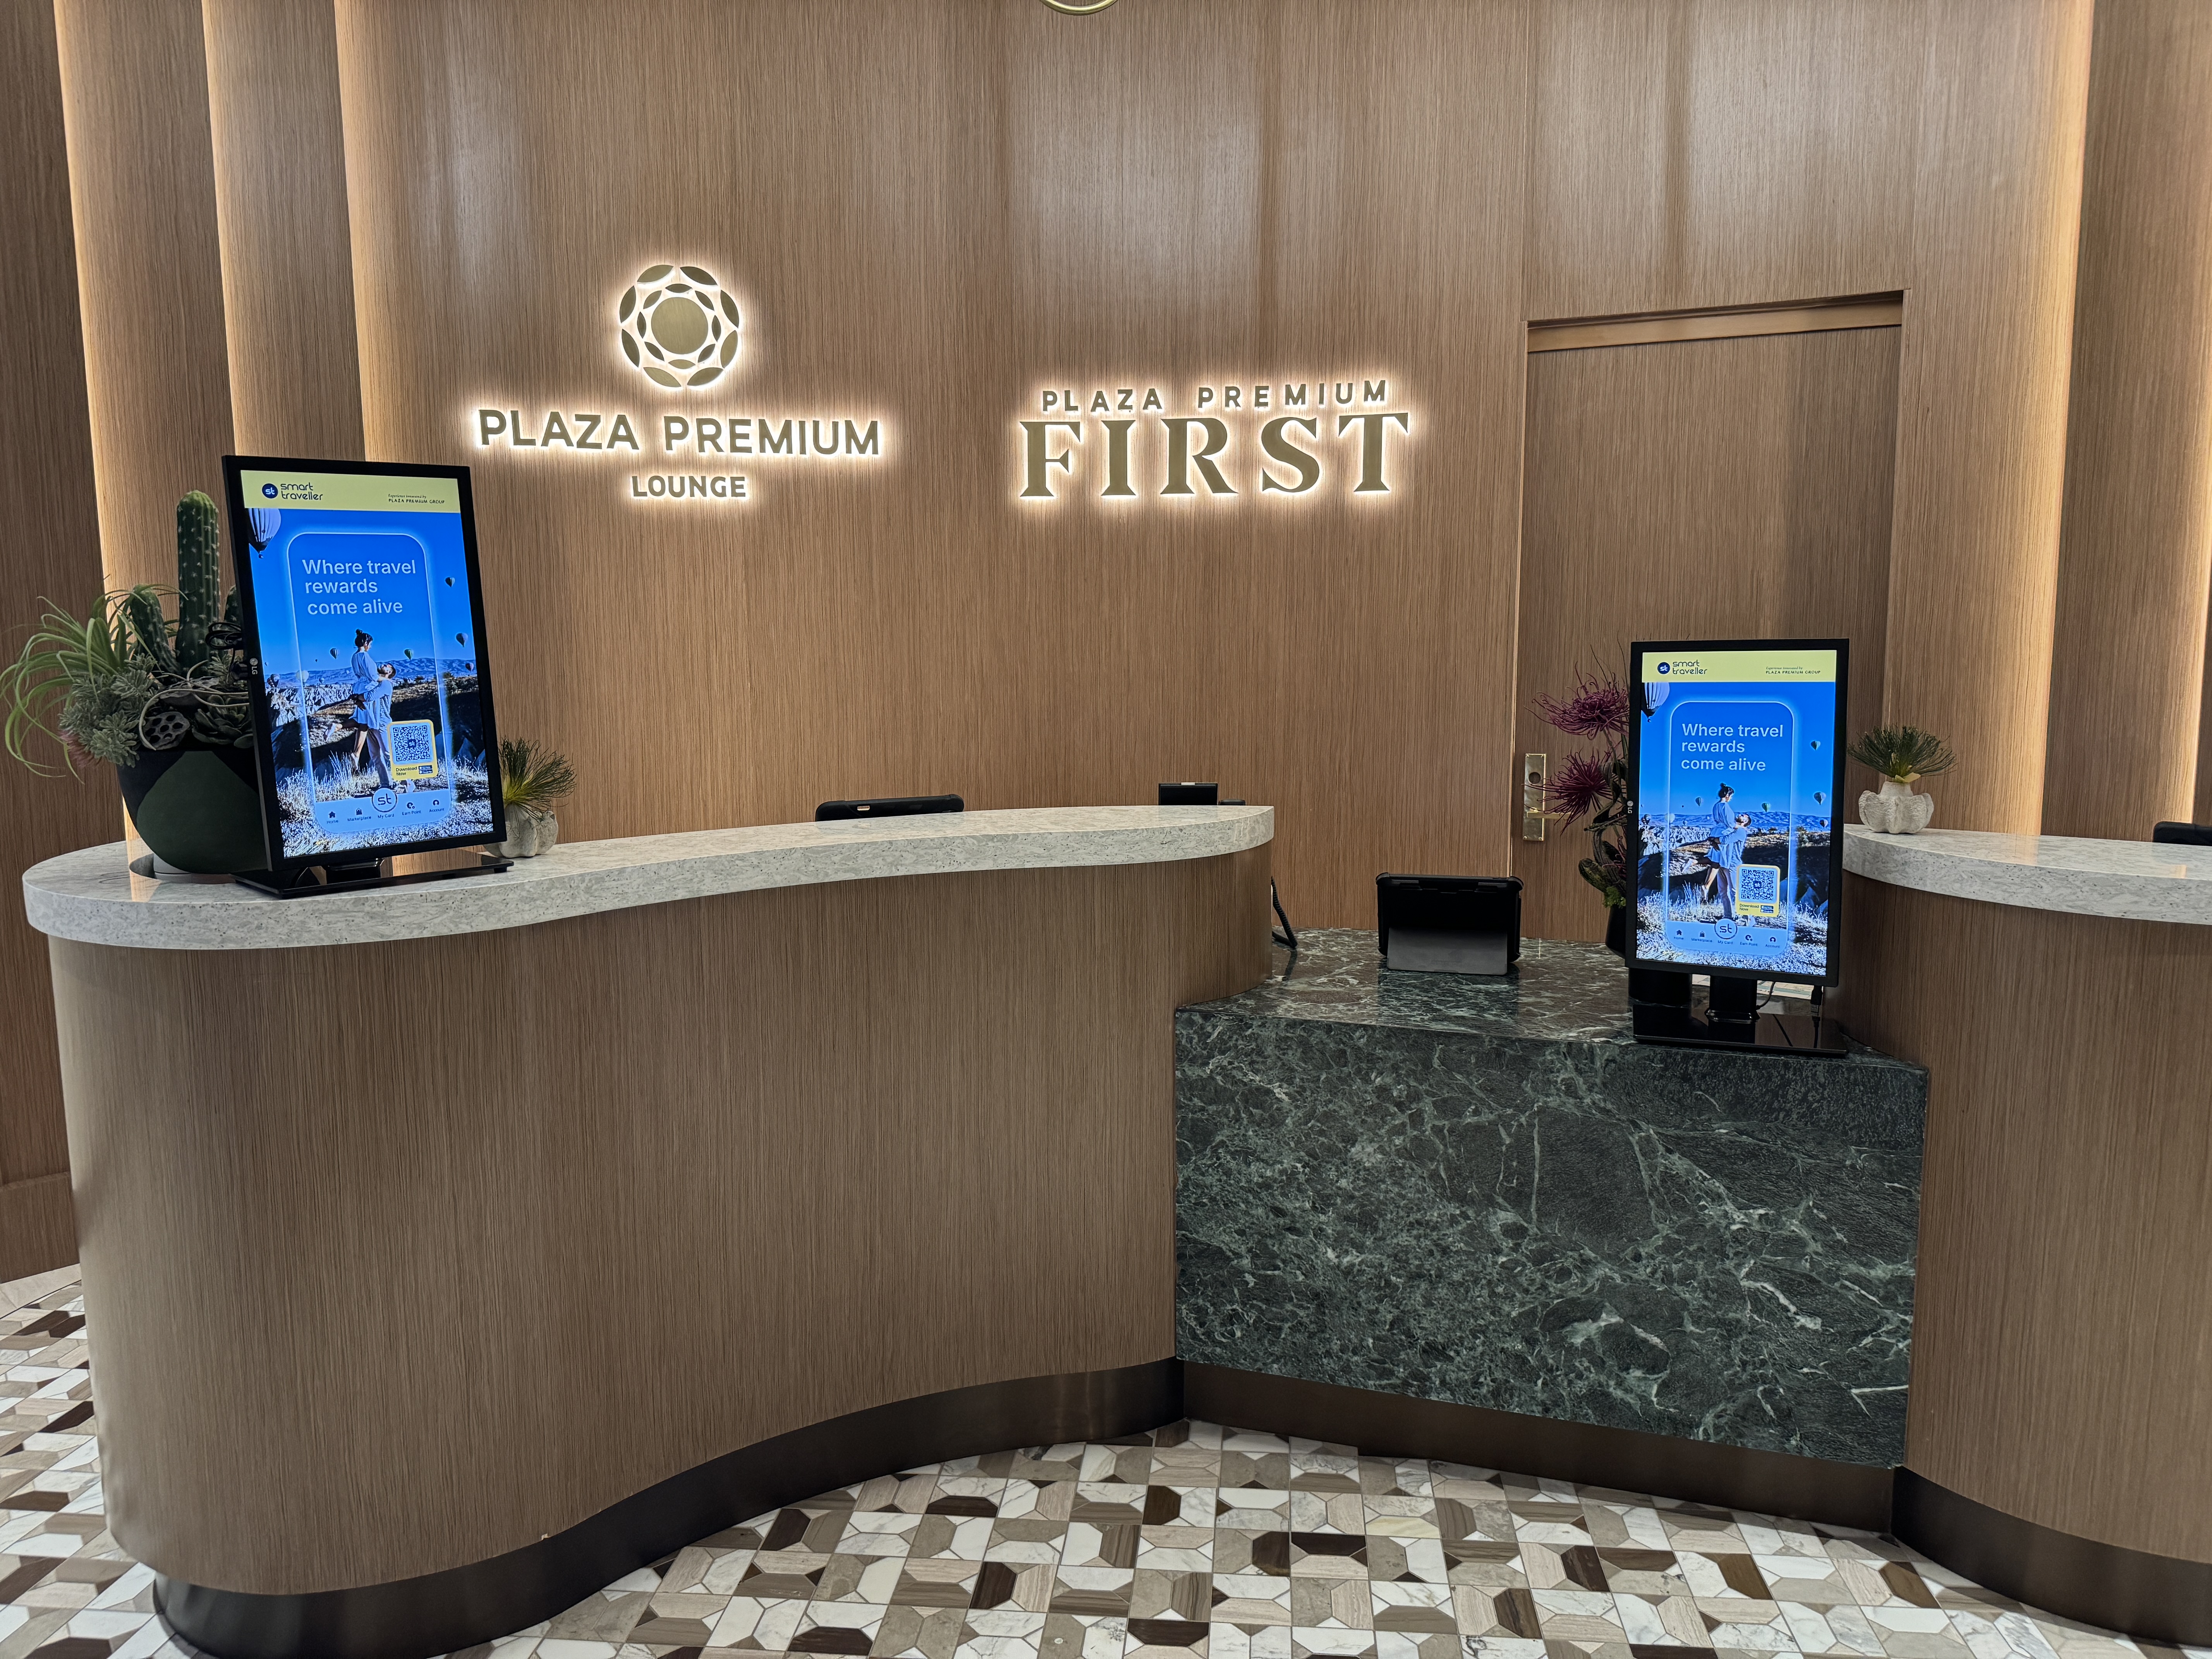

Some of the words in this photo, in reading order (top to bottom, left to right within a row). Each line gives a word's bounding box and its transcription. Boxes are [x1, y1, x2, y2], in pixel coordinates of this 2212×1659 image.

[1042, 388, 1162, 412] PLAZA
[1198, 380, 1385, 408] PREMIUM
[479, 410, 639, 450] PLAZA
[664, 416, 878, 455] PREMIUM
[1020, 413, 1408, 497] FIRST
[280, 482, 313, 491] smart
[632, 476, 745, 498] LOUNGE
[281, 490, 323, 500] traveller
[302, 559, 362, 574] Where
[367, 559, 416, 574] travel
[305, 579, 378, 593] rewards
[307, 601, 357, 615] come
[363, 599, 403, 613] alive
[252, 666, 258, 675] LG
[1682, 723, 1733, 737] Where
[1738, 724, 1783, 737] travel
[1681, 740, 1745, 752] rewards
[1681, 759, 1724, 770] come
[1729, 758, 1766, 771] alive
